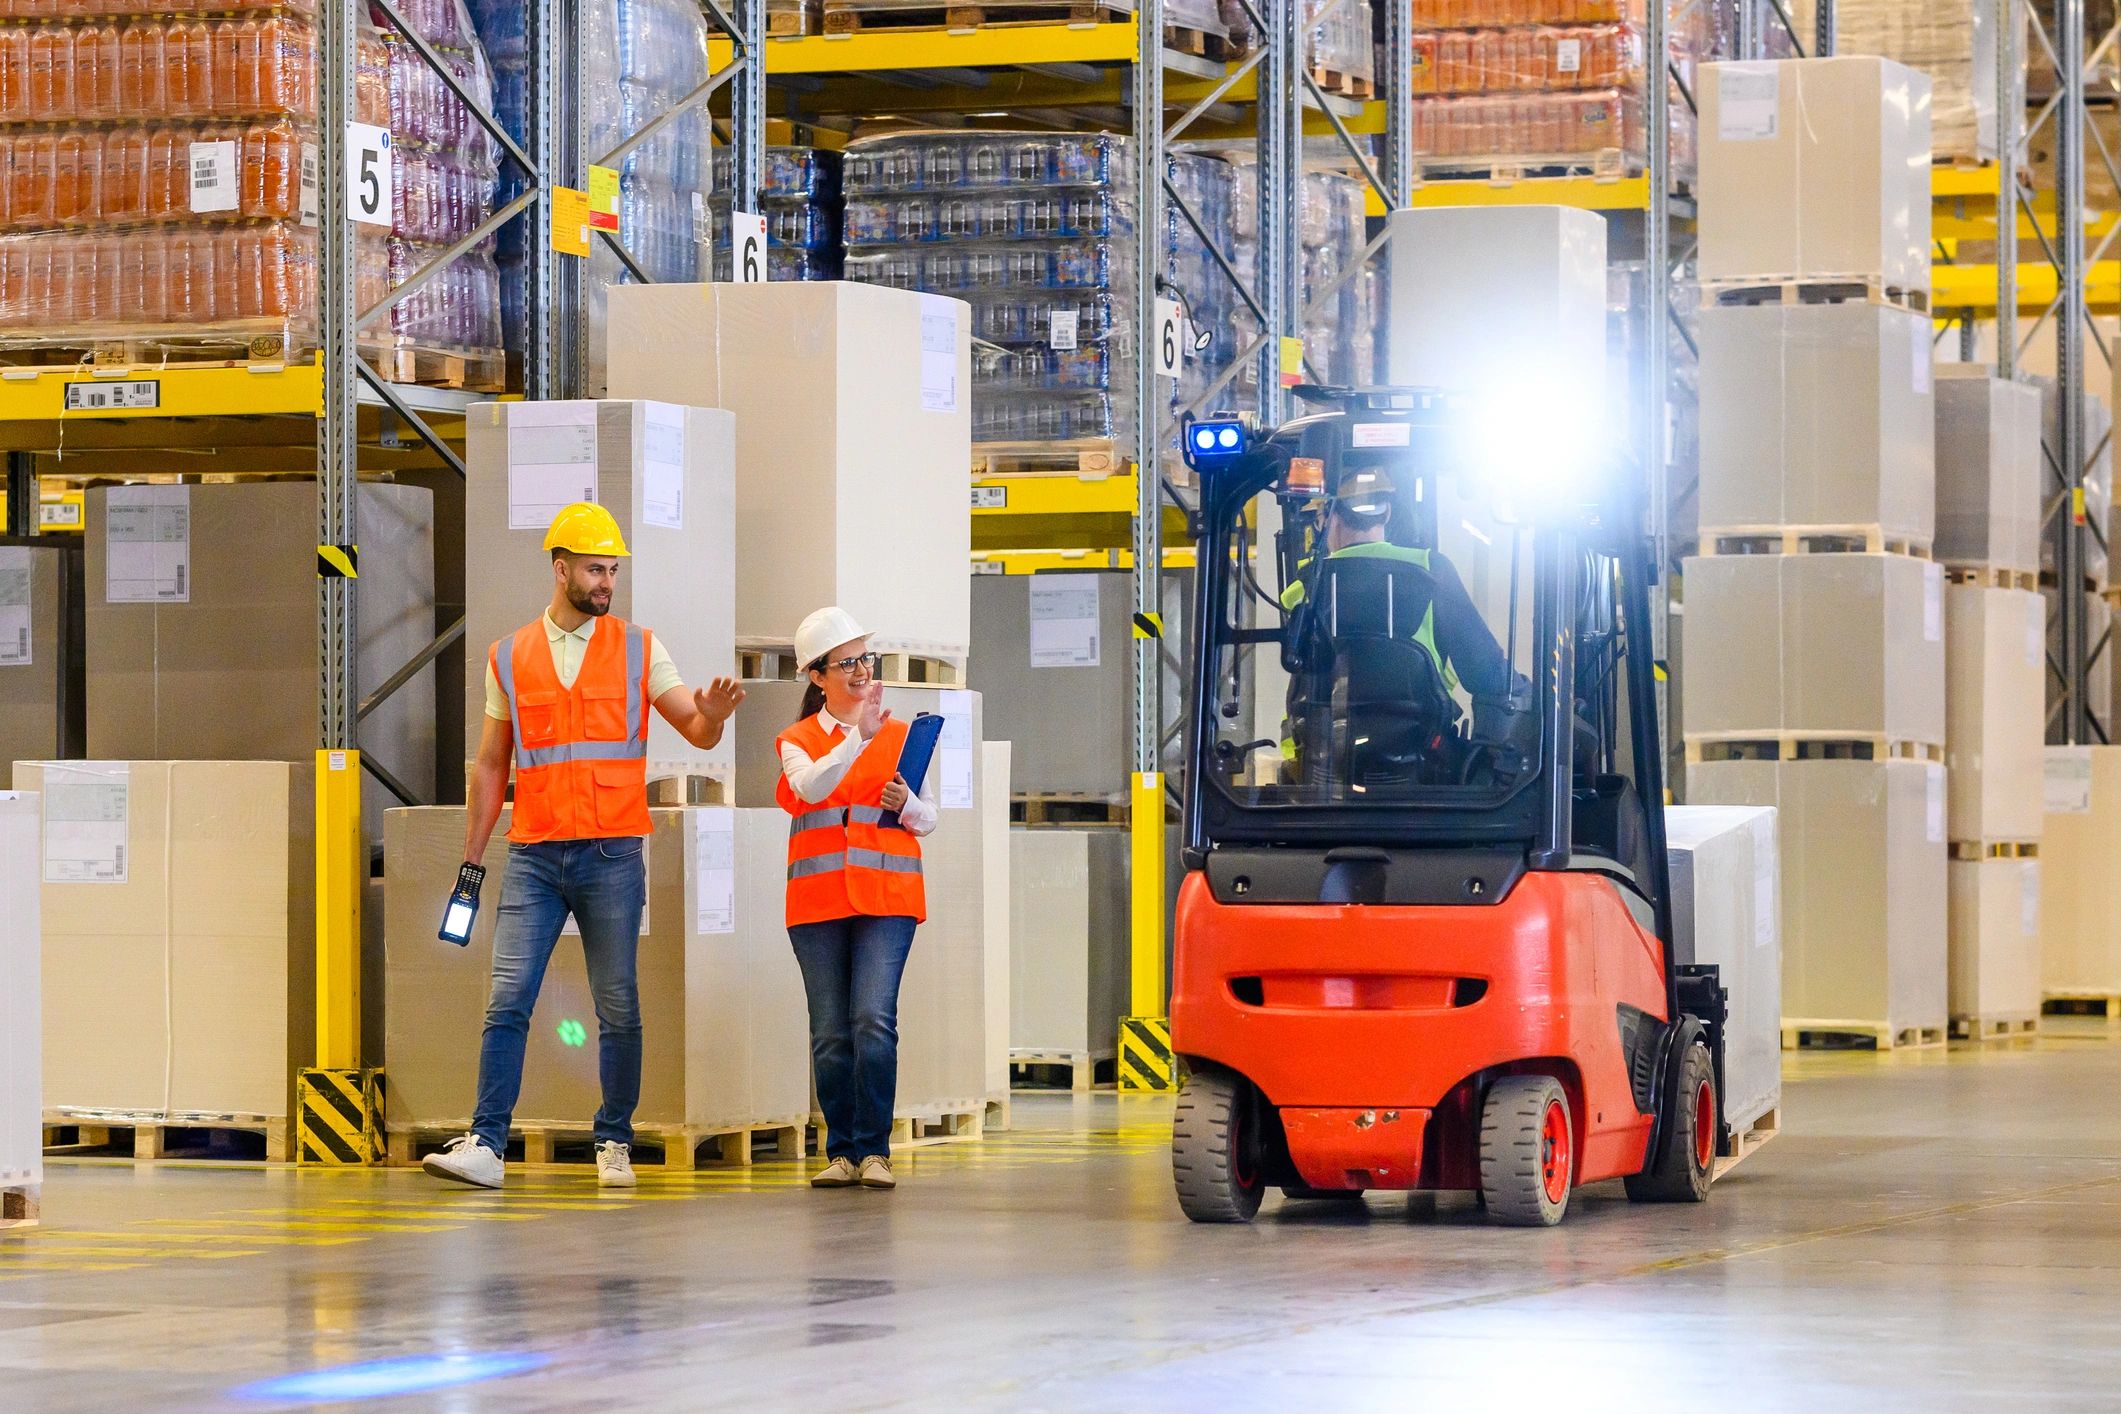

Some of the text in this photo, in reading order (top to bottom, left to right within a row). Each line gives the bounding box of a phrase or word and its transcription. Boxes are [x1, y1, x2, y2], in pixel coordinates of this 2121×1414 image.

[360, 148, 379, 215] 5
[743, 236, 758, 282] 6
[1163, 318, 1175, 370] 6
